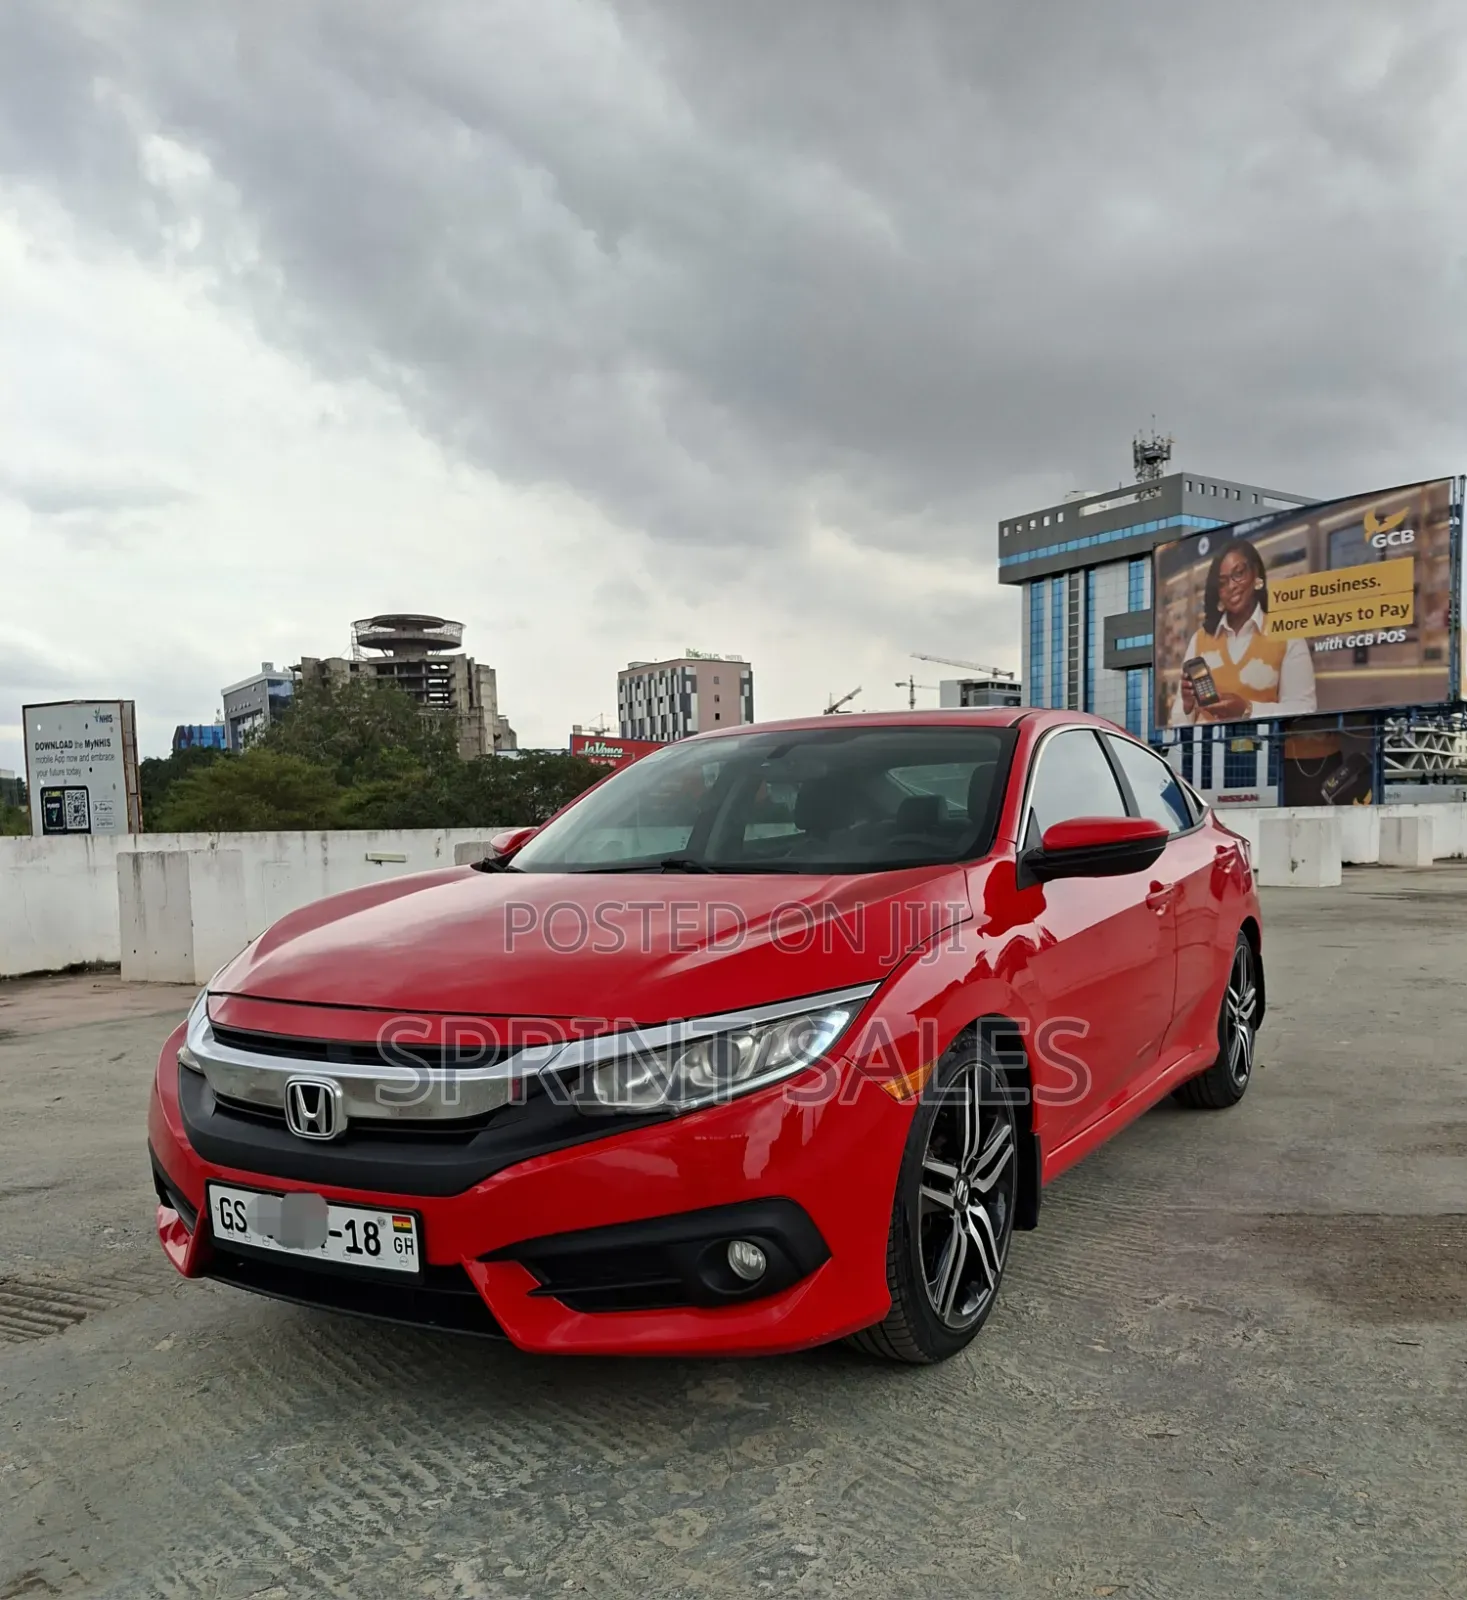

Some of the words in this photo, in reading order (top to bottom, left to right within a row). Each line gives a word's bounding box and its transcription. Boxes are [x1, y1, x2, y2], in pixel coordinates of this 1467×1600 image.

[1372, 529, 1415, 548] GCB
[1273, 588, 1305, 603] Your
[1310, 577, 1381, 597] Business.
[1271, 618, 1308, 632] More
[1313, 611, 1353, 627] Ways
[1358, 607, 1374, 621] to
[1380, 604, 1410, 618] Pay
[1314, 637, 1343, 652] with
[1346, 634, 1374, 648] GCB
[1377, 629, 1407, 645] POS
[99, 714, 113, 723] NHIS
[35, 740, 73, 751] DOWNLOAD
[74, 741, 83, 750] the
[84, 738, 111, 750] MyNHIS
[35, 756, 53, 764] mobile
[54, 755, 65, 764] App
[79, 753, 89, 762] and
[91, 752, 115, 761] embrace
[36, 769, 48, 779] your
[49, 768, 65, 777] future
[1217, 794, 1260, 802] NISSAN
[393, 1237, 415, 1256] GH
